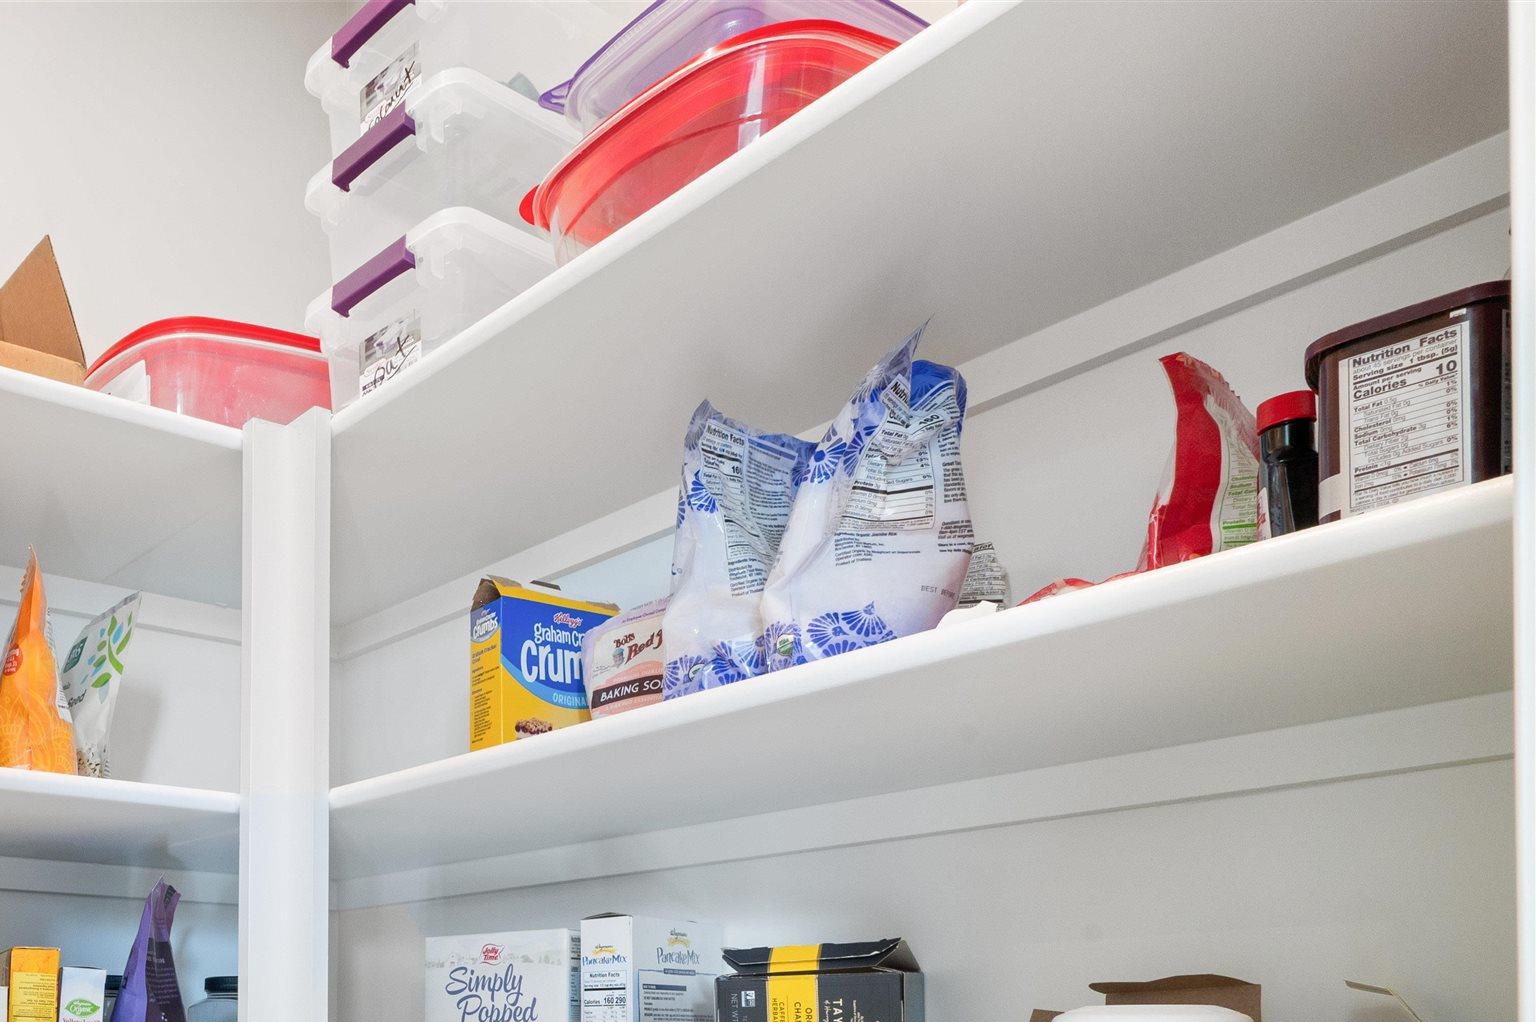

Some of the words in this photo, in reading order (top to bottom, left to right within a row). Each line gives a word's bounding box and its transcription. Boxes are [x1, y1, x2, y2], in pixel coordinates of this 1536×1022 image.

[1352, 344, 1410, 368] Nutrition
[1419, 329, 1458, 347] Facts
[1353, 379, 1407, 400] Calories
[1435, 359, 1457, 375] 10
[553, 612, 583, 628] Kellogg's
[533, 622, 571, 644] graham
[613, 633, 636, 649] Bob's
[625, 637, 654, 664] Red
[600, 680, 639, 702] BAKING
[445, 963, 523, 1006] Simply
